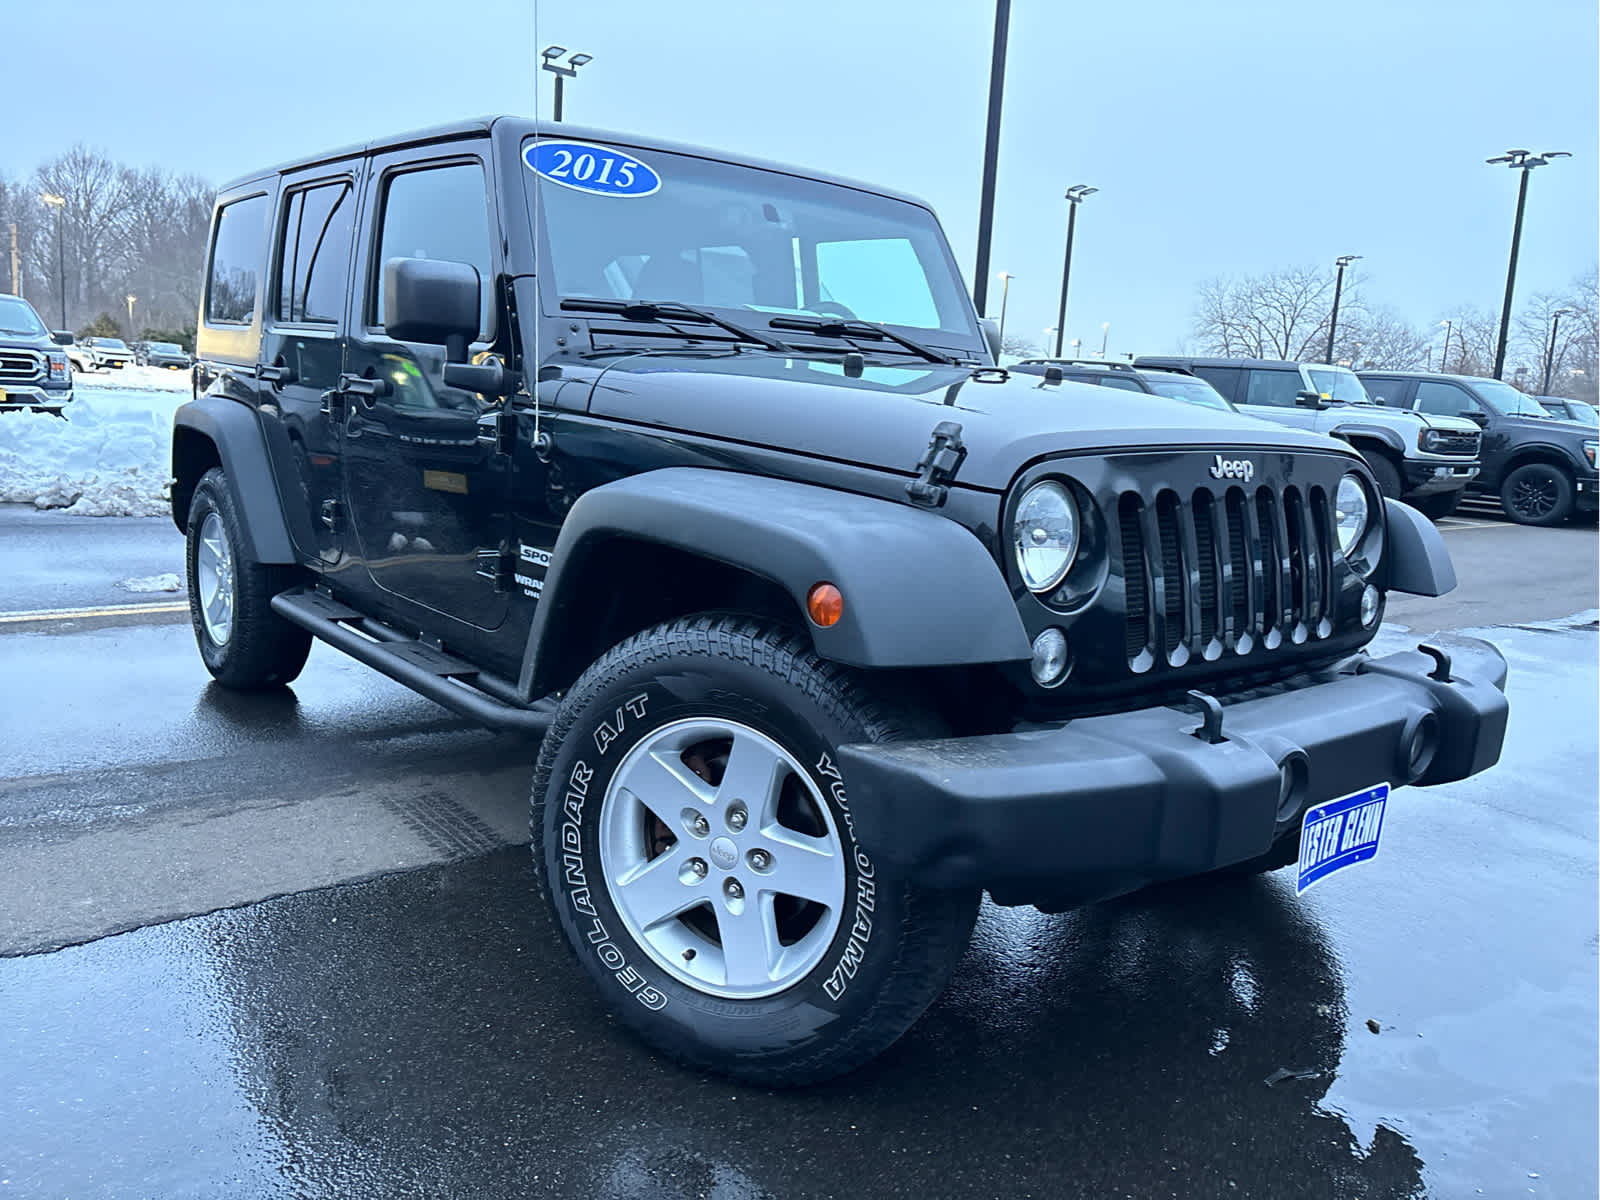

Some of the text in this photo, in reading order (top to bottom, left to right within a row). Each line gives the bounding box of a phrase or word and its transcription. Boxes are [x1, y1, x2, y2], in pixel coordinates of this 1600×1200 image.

[548, 150, 638, 188] 2015
[1210, 454, 1254, 483] Jeep
[523, 548, 552, 563] SPO
[1340, 800, 1385, 852] GLENN
[562, 692, 668, 1011] GEOLANDAR A/T
